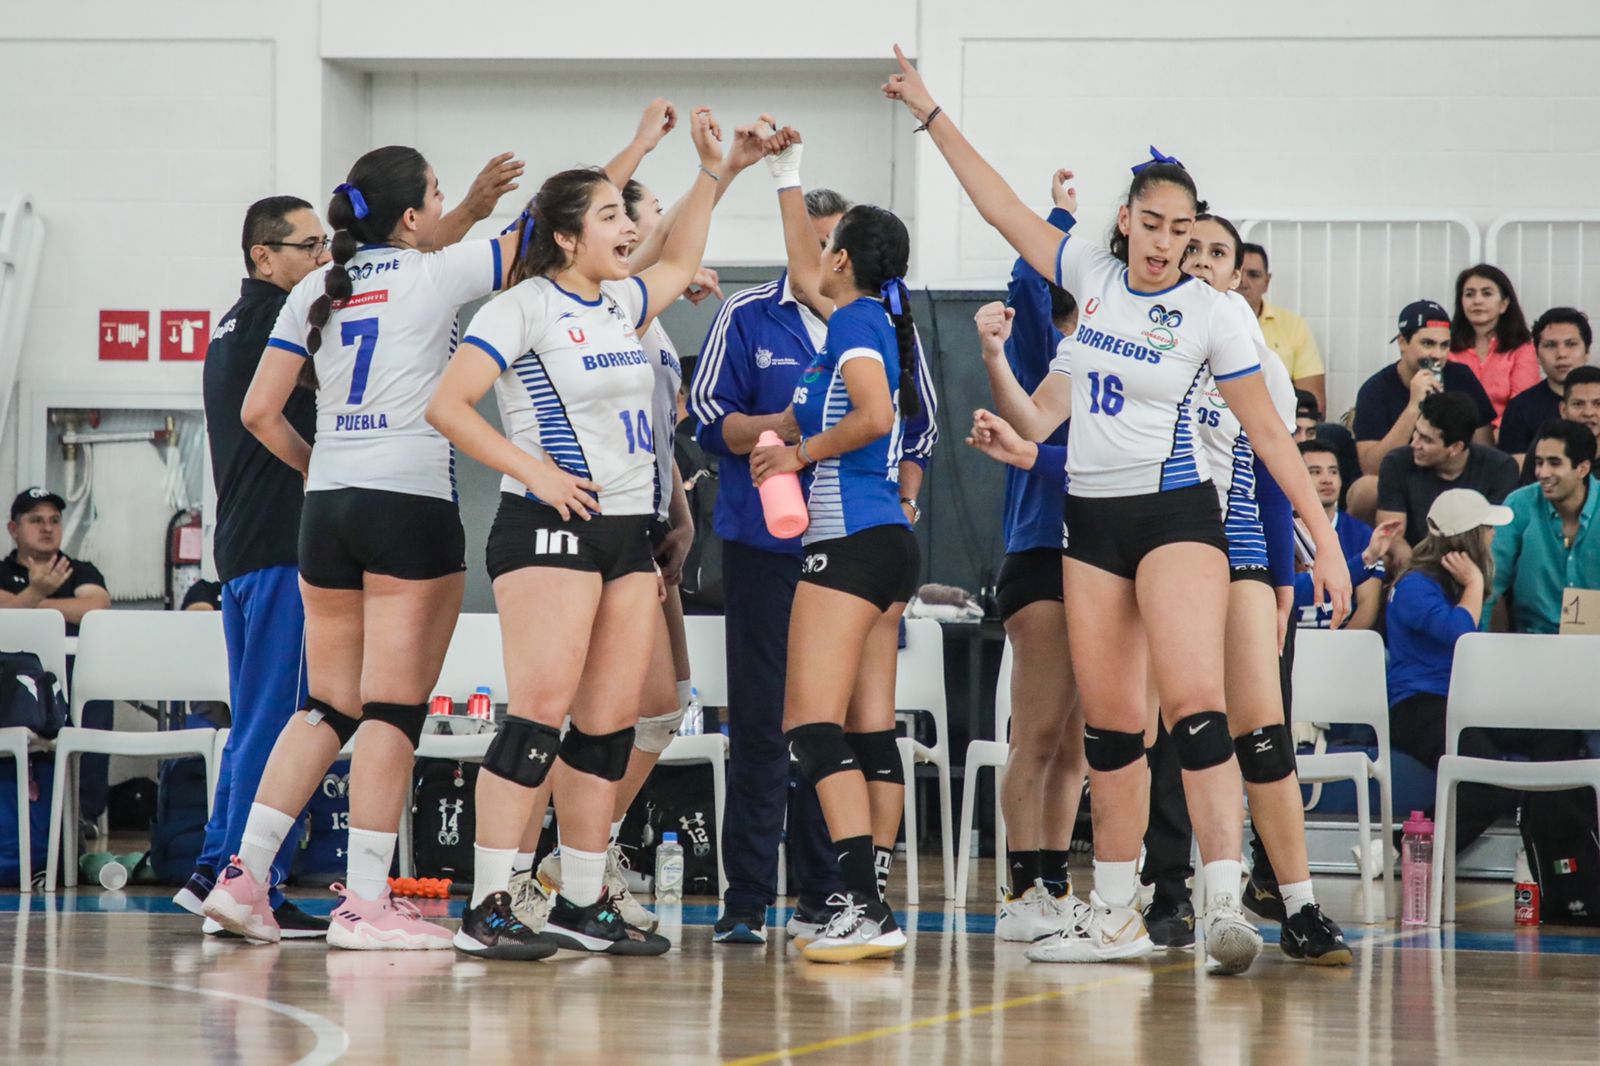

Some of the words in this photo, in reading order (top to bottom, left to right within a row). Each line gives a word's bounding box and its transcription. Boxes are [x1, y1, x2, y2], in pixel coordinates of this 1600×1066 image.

[1076, 323, 1163, 365] BORREGOS
[341, 316, 379, 405] 7
[581, 349, 649, 371] BORREGO
[1087, 371, 1125, 417] 16
[335, 413, 389, 431] PUEBLA
[618, 409, 654, 455] 10
[331, 812, 350, 830] 13
[441, 812, 458, 831] 14
[687, 827, 709, 844] 12
